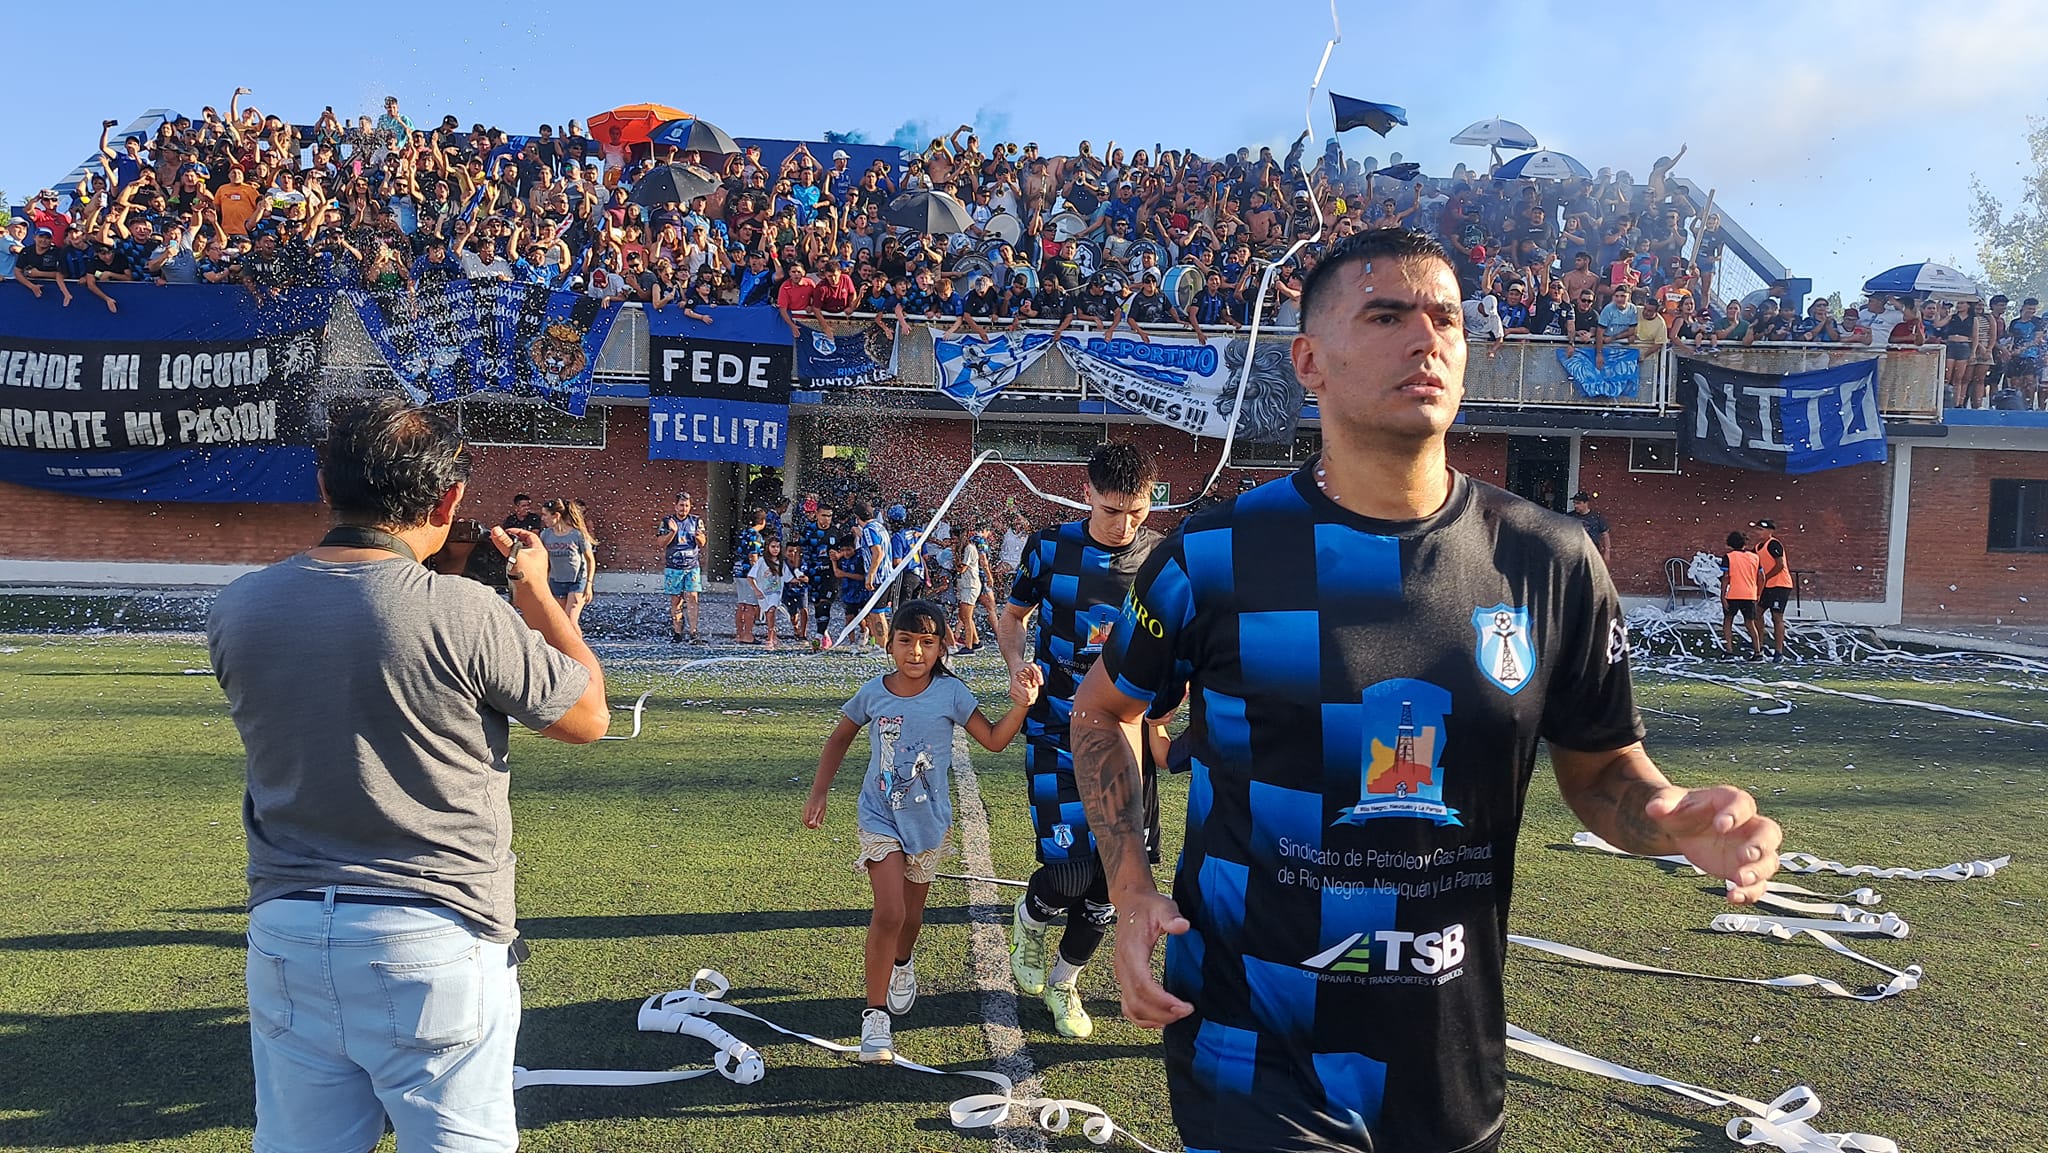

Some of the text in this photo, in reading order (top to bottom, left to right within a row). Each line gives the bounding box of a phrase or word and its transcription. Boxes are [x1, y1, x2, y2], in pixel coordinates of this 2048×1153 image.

[525, 313, 541, 326] en
[101, 354, 140, 390] MI
[158, 349, 269, 389] LOCURA
[663, 349, 771, 389] FEDE
[1089, 339, 1217, 377] DEPORTIVO
[810, 376, 853, 388] JUNTO
[855, 373, 871, 386] AL
[1090, 363, 1126, 382] MALAS
[1131, 380, 1174, 398] MUCHO
[124, 411, 165, 446] MI
[177, 399, 277, 444] PASION
[1693, 370, 1883, 452] NITO
[652, 412, 778, 450] TECLITA
[1279, 837, 1341, 866] Sindicato
[1344, 849, 1363, 867] de
[1366, 849, 1423, 870] Petróleo
[1424, 854, 1432, 873] y
[1433, 847, 1456, 866] Gas
[1278, 865, 1296, 885] de
[1323, 876, 1368, 900] Negro,
[1373, 877, 1431, 901] Neuquén
[1431, 880, 1440, 899] y
[1440, 874, 1453, 892] La
[1454, 870, 1493, 889] Pampa
[1375, 923, 1466, 975] TSB
[1354, 974, 1367, 985] DE
[1368, 974, 1430, 986] TRANSPORTES
[1431, 975, 1438, 986] Y
